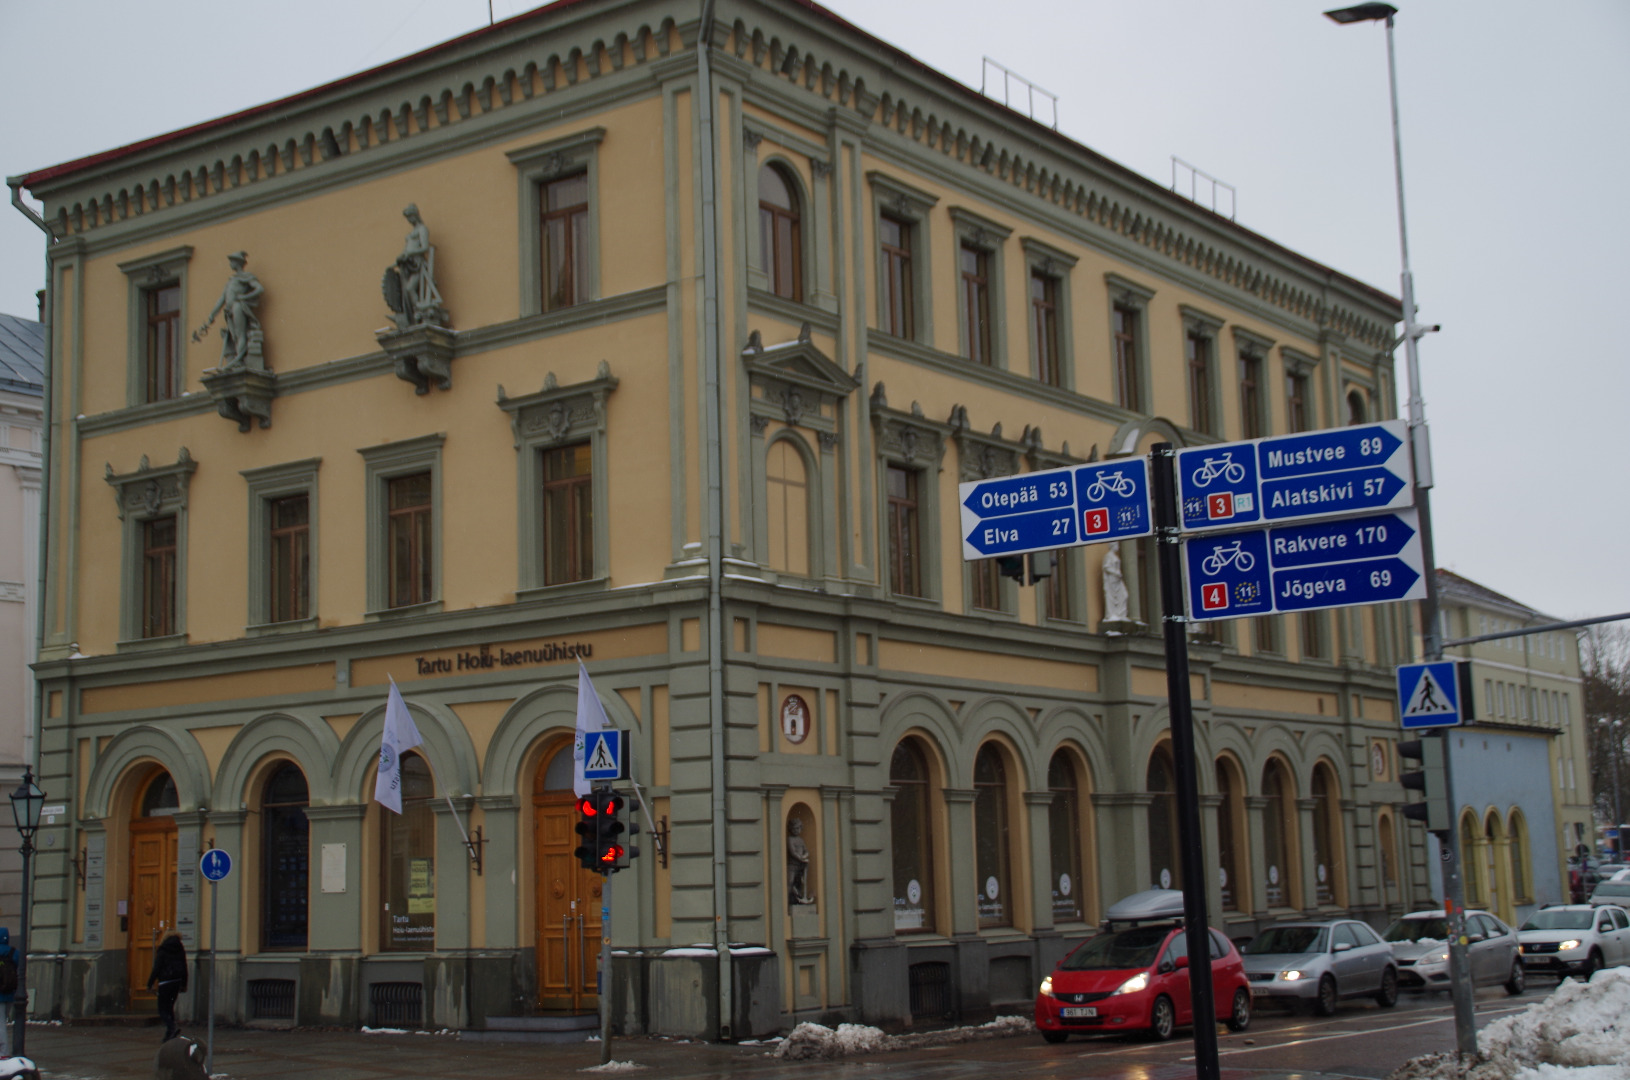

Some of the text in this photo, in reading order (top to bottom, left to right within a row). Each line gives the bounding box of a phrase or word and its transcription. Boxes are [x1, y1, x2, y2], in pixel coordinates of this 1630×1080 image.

[1268, 437, 1383, 468] Mustvee 89
[981, 481, 1068, 508] Otepää 53
[1237, 496, 1251, 508] R1
[1271, 477, 1385, 508] Alatskivi 57
[1120, 511, 1132, 522] 11
[1186, 501, 1200, 513] 11
[1215, 497, 1226, 514] 3
[984, 518, 1071, 546] Elva 27
[1093, 514, 1102, 529] 3
[1274, 525, 1388, 555] Rakvere 170
[1239, 586, 1252, 598] 11
[1280, 578, 1347, 600] Jõgeva
[1369, 569, 1392, 588] 69
[1209, 587, 1220, 605] 4
[417, 642, 593, 675] Tartu Hoiu-laenuühistu
